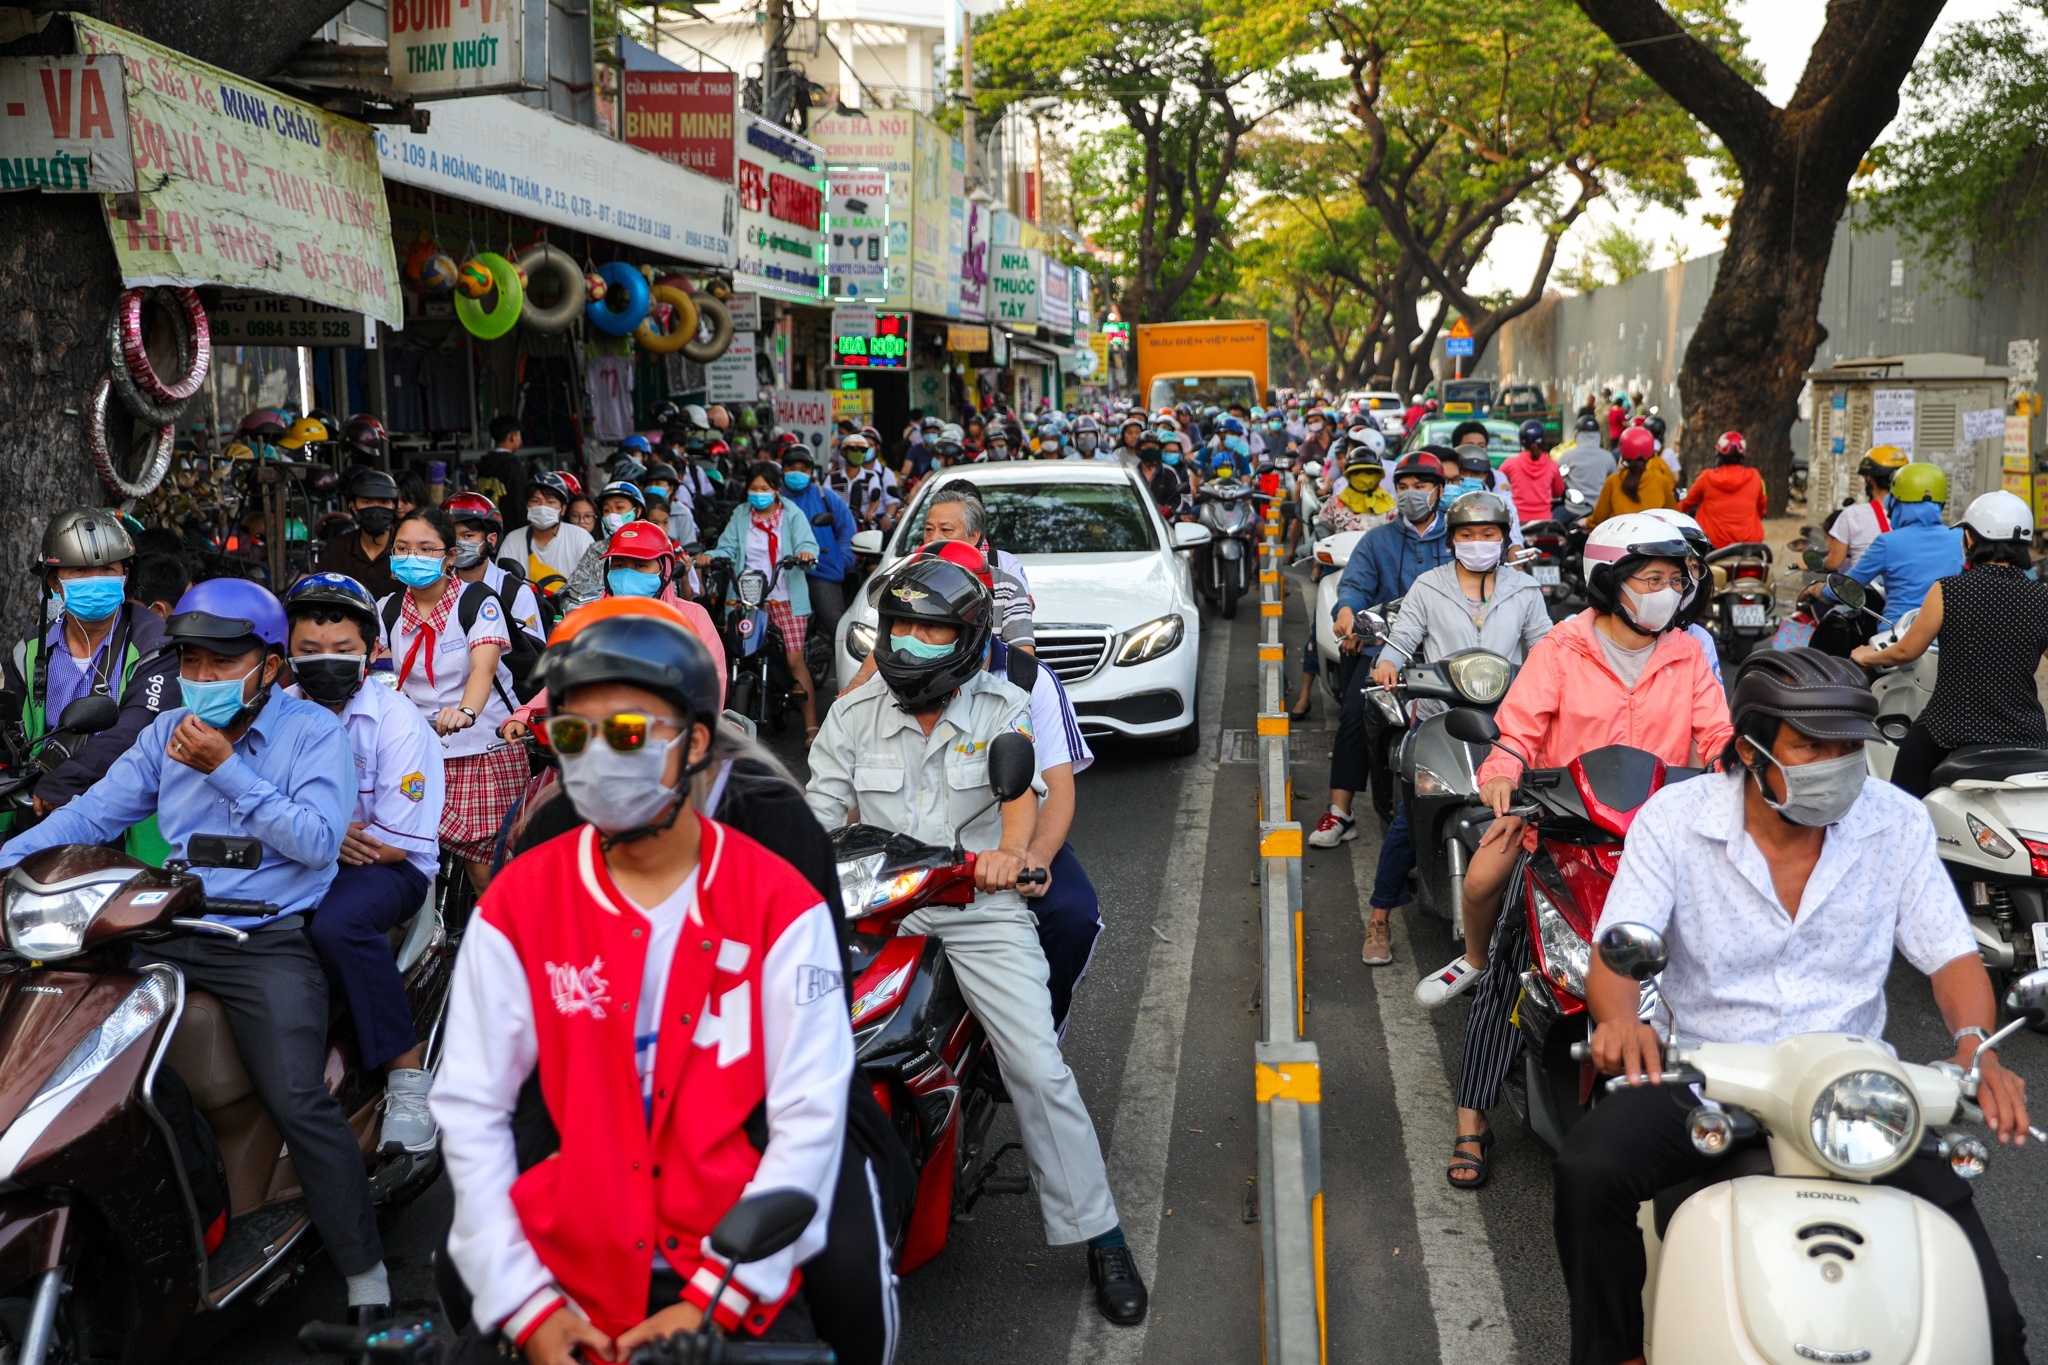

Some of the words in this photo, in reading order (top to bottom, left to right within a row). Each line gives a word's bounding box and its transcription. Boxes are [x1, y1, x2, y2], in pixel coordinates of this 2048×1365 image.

[407, 43, 447, 73] THAY
[453, 33, 498, 69] NHỚT
[39, 54, 114, 138] VÁ
[650, 79, 678, 95] HÀNG
[680, 76, 702, 96] THỂ
[703, 83, 732, 96] THAO
[147, 57, 189, 101] Sửa
[190, 74, 218, 111] Xe
[221, 86, 271, 130] MINH
[273, 105, 321, 147] CHÂU
[627, 104, 673, 138] BÌNH
[681, 112, 732, 139] MINH
[851, 115, 873, 136] HÀ
[879, 114, 908, 140] NỘI
[866, 142, 895, 158] HIỆU
[0, 150, 88, 191] NHỚT
[172, 122, 215, 186] VÁ
[216, 130, 249, 196] ÉP
[265, 166, 316, 216] THAY
[317, 171, 343, 224] VỎ
[402, 142, 426, 168] 109
[430, 151, 438, 172] A
[442, 154, 482, 185] HOÀNG
[485, 168, 507, 192] HOA
[616, 210, 636, 230] 0122
[832, 184, 851, 196] XE
[856, 183, 883, 197] HƠI
[831, 216, 848, 228] XE
[208, 217, 276, 269] NHỚT
[1001, 250, 1029, 270] NHÀ
[993, 274, 1035, 295] THUỐC
[999, 297, 1026, 318] TÂY
[247, 320, 284, 337] 0984
[289, 321, 317, 338] 535
[322, 321, 350, 338] 528
[870, 333, 905, 359] NỘI
[1205, 334, 1228, 346] VIỆT
[1230, 334, 1255, 344] NAM
[798, 397, 826, 425] KHÓA
[21, 986, 64, 994] HONDA
[902, 1050, 930, 1071] HONDA
[1795, 1190, 1861, 1205] HONDA
